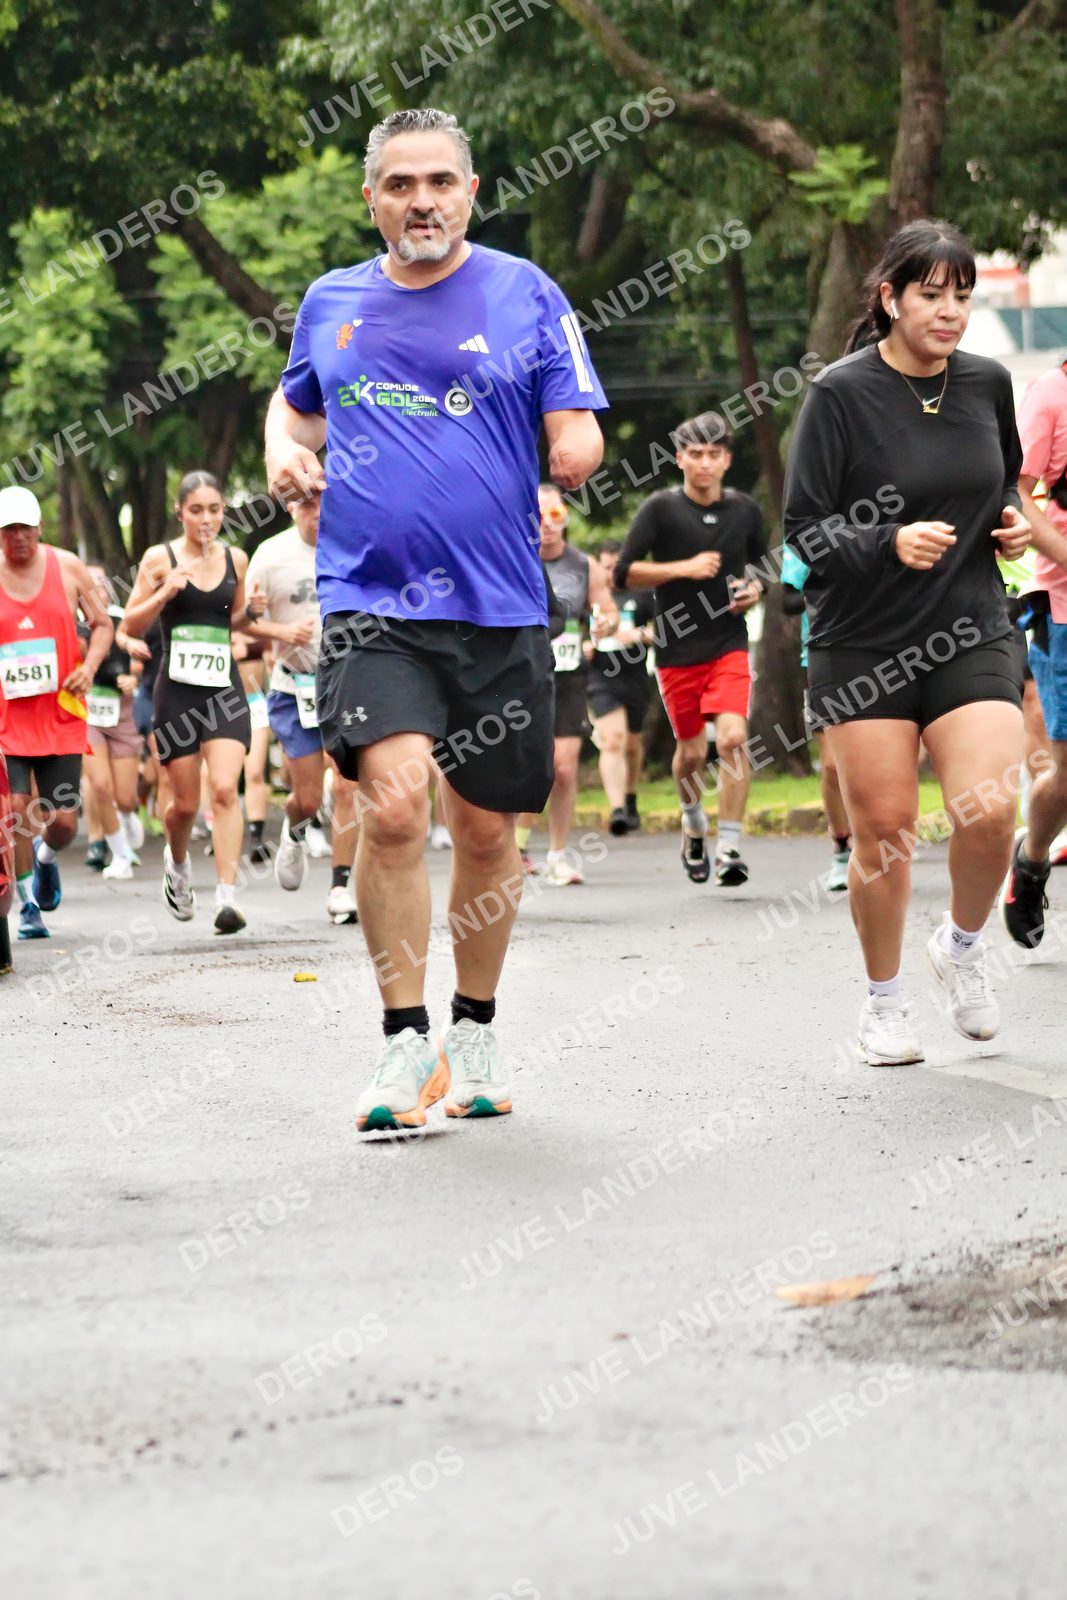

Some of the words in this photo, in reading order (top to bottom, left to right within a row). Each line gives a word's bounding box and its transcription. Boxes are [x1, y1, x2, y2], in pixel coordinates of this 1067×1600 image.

[338, 375, 376, 408] 21K
[376, 391, 420, 407] GDL
[178, 652, 225, 672] 1770
[5, 665, 52, 683] 4581
